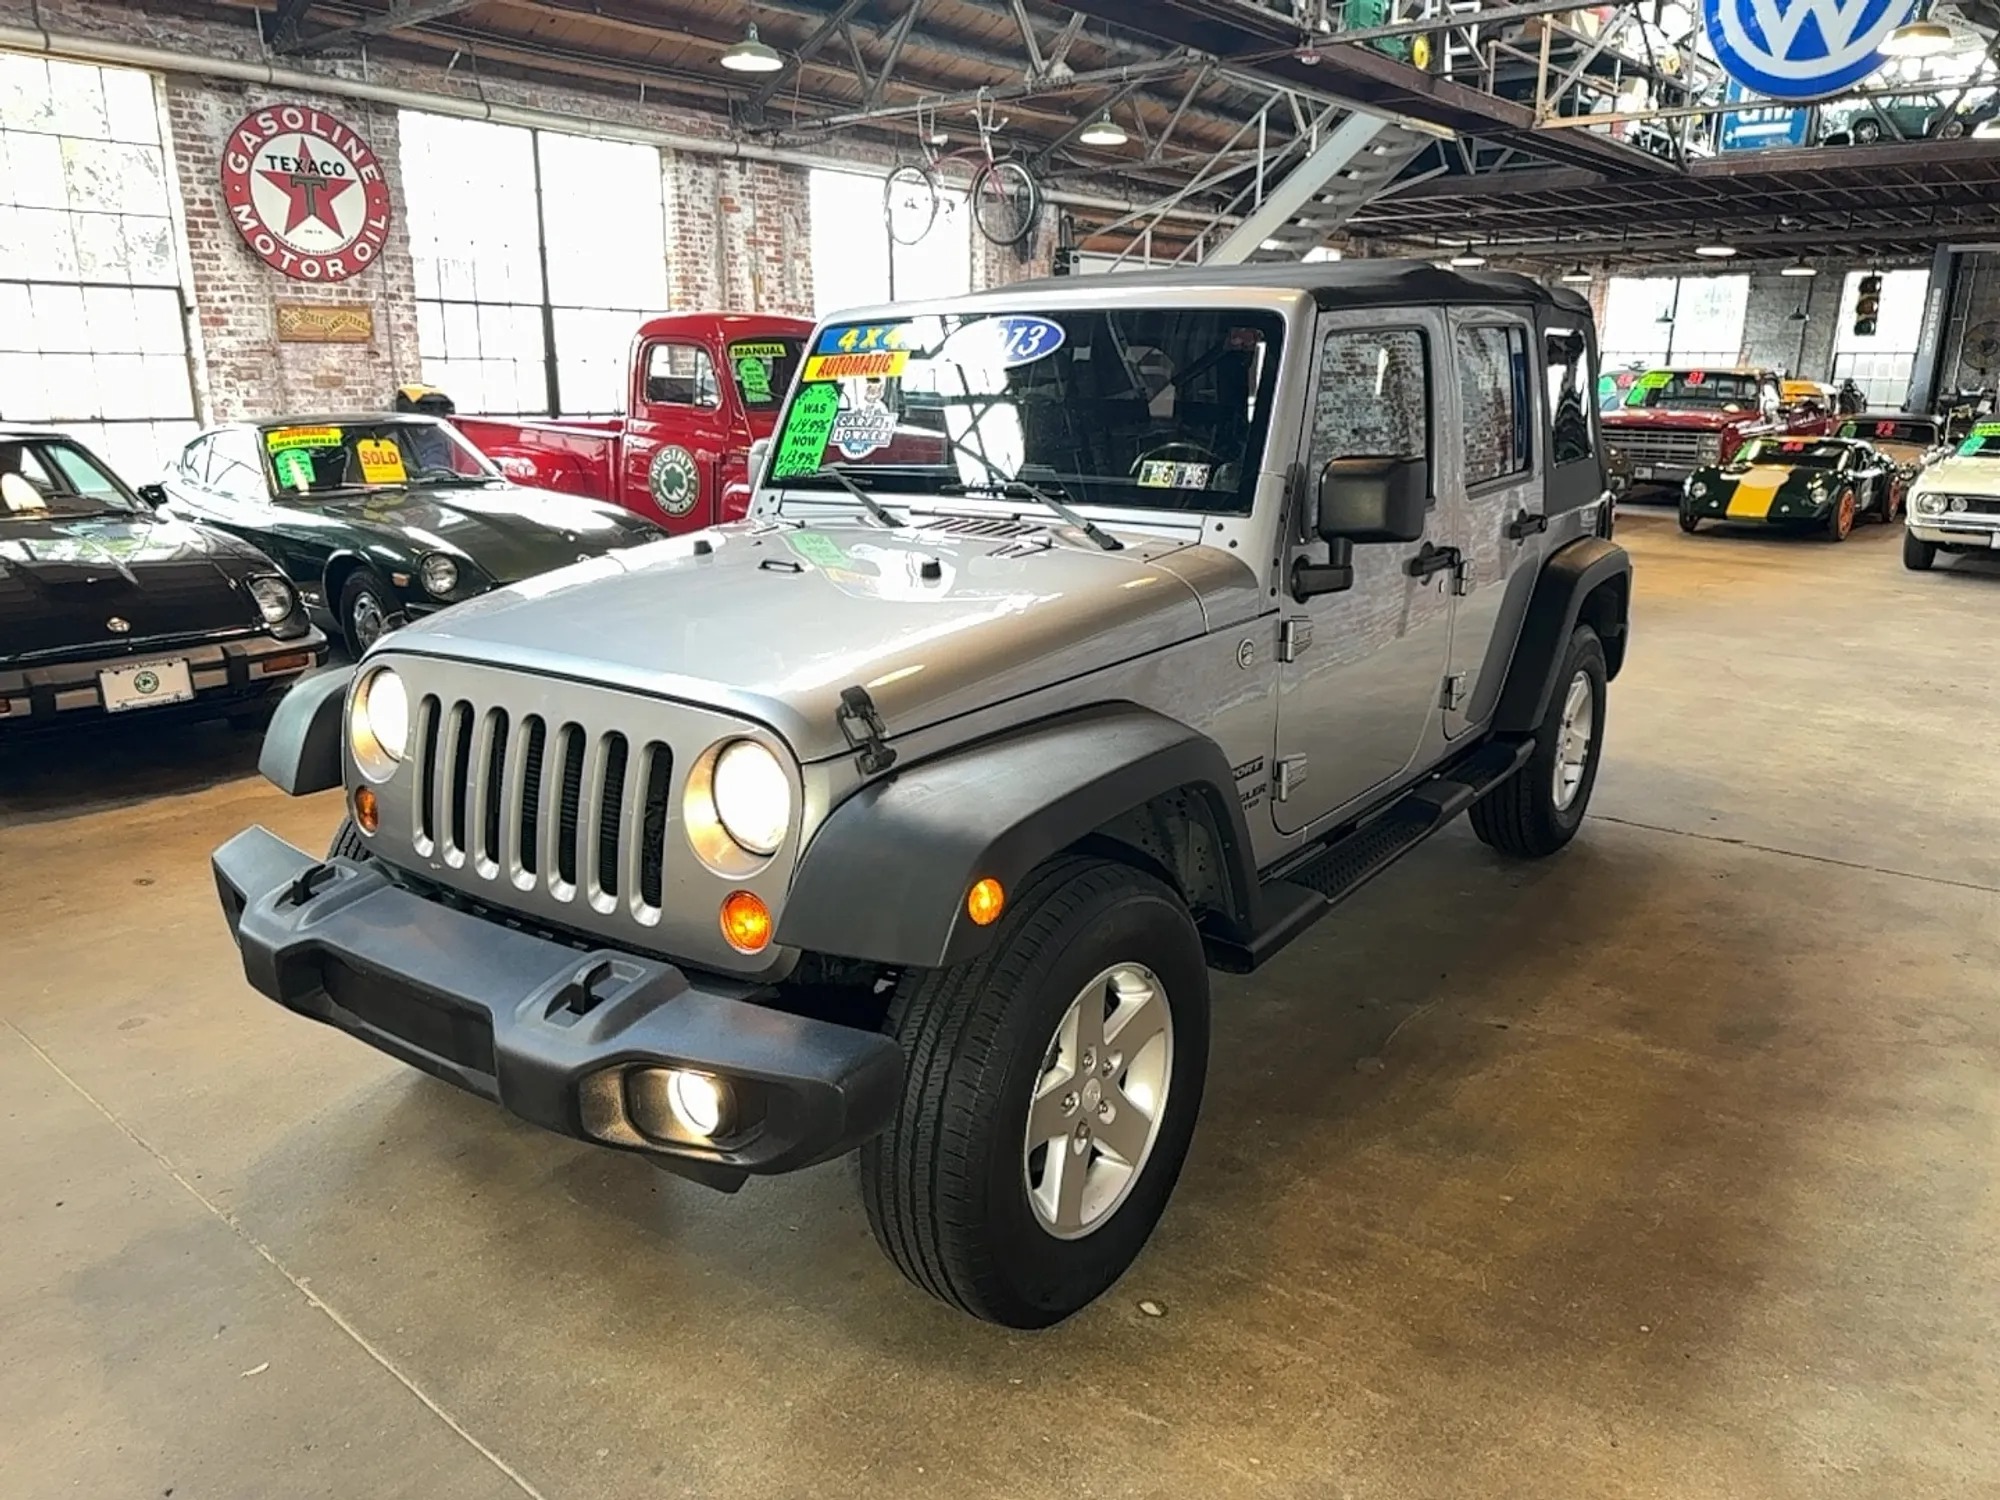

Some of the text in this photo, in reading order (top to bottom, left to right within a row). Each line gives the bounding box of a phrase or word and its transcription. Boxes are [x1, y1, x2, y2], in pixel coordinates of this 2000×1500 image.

[227, 107, 381, 184] GASOLINE
[265, 154, 346, 177] TEXACO
[234, 204, 386, 278] MOTOR OIL
[733, 346, 783, 357] MANUAL
[816, 354, 895, 378] AUTOMATIC
[803, 403, 828, 414] WAS
[791, 436, 818, 447] NOW
[361, 450, 399, 465] SOLD
